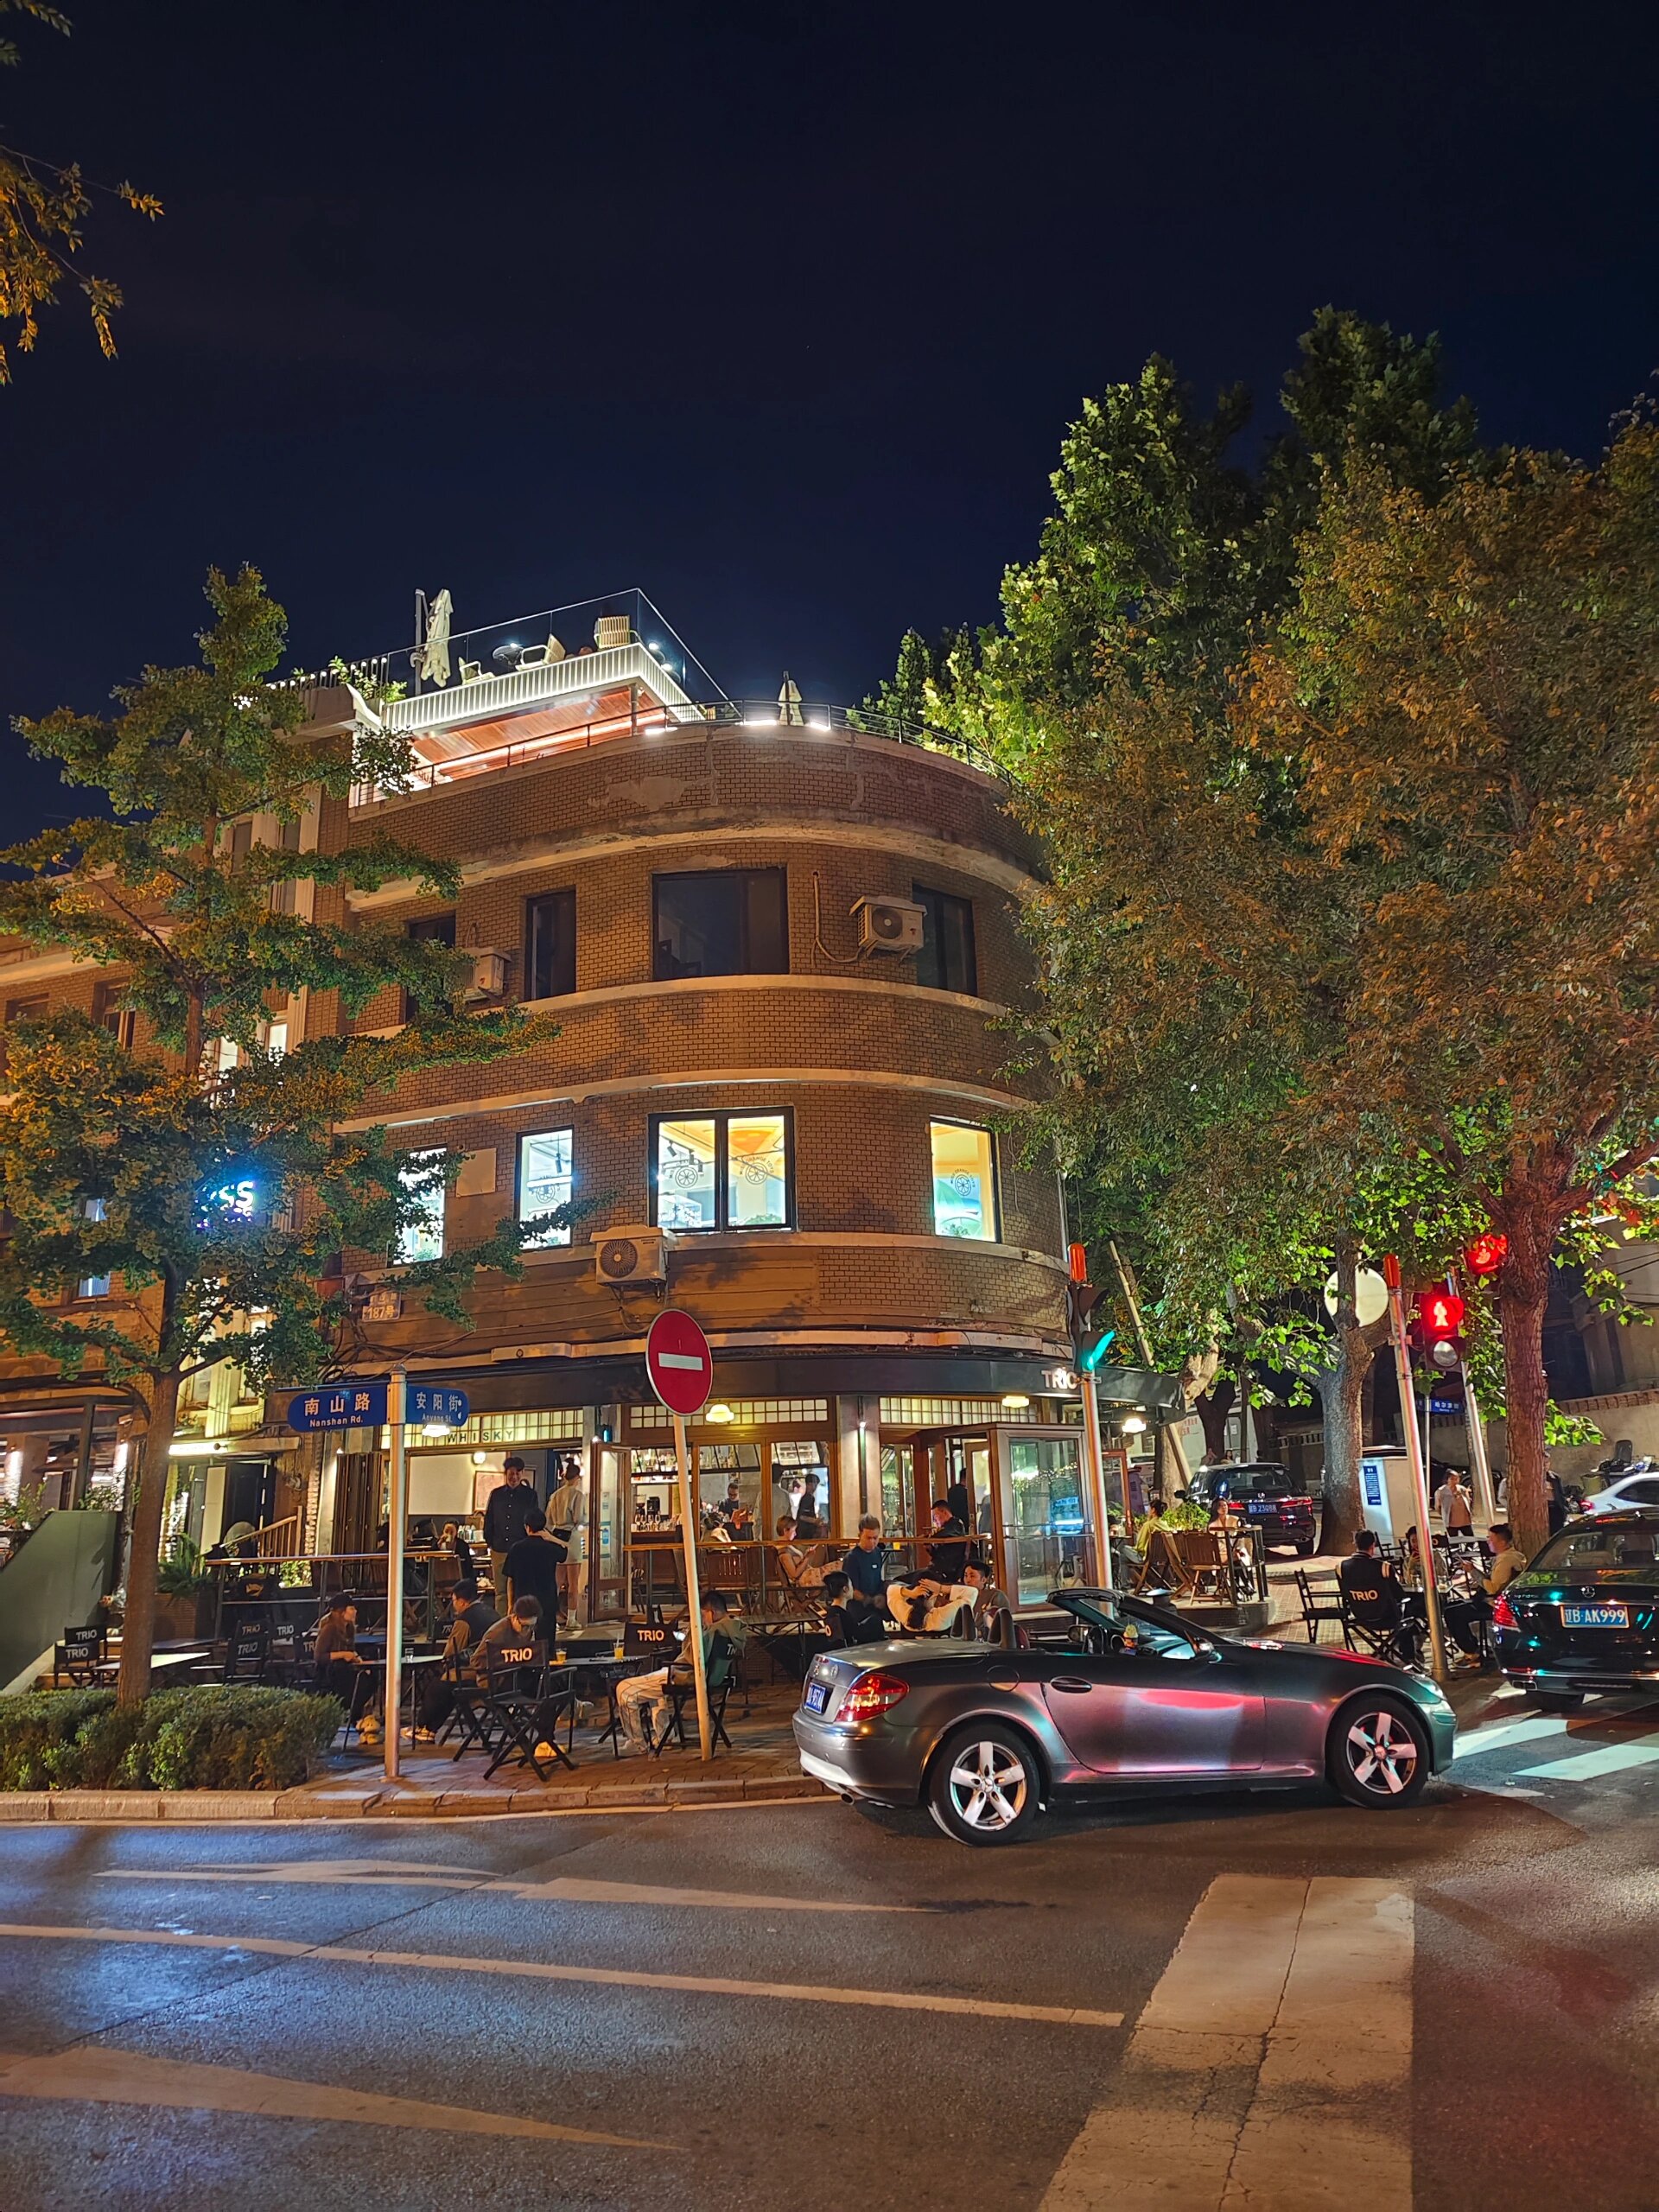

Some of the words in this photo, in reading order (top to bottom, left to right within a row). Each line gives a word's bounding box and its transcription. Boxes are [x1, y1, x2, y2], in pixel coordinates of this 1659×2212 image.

[367, 1305, 395, 1319] 187号
[1041, 1367, 1078, 1390] TRIO
[304, 1392, 371, 1416] 南山路
[416, 1391, 459, 1412] 安阳街
[309, 1415, 347, 1427] Nanshan
[350, 1414, 363, 1424] Rd.
[448, 1429, 513, 1443] WHISKY
[1350, 1590, 1378, 1601] TRIO
[1565, 1608, 1626, 1624] 辽B·AK999
[76, 1629, 98, 1641] TRIO
[242, 1624, 261, 1635] TRIO
[276, 1624, 295, 1636] TRIO
[442, 1624, 452, 1634] TR
[637, 1630, 664, 1642] TRIO
[66, 1647, 89, 1659] TRIO
[238, 1642, 258, 1655] TRIO
[303, 1641, 317, 1652] TR
[501, 1648, 532, 1662] TRIO
